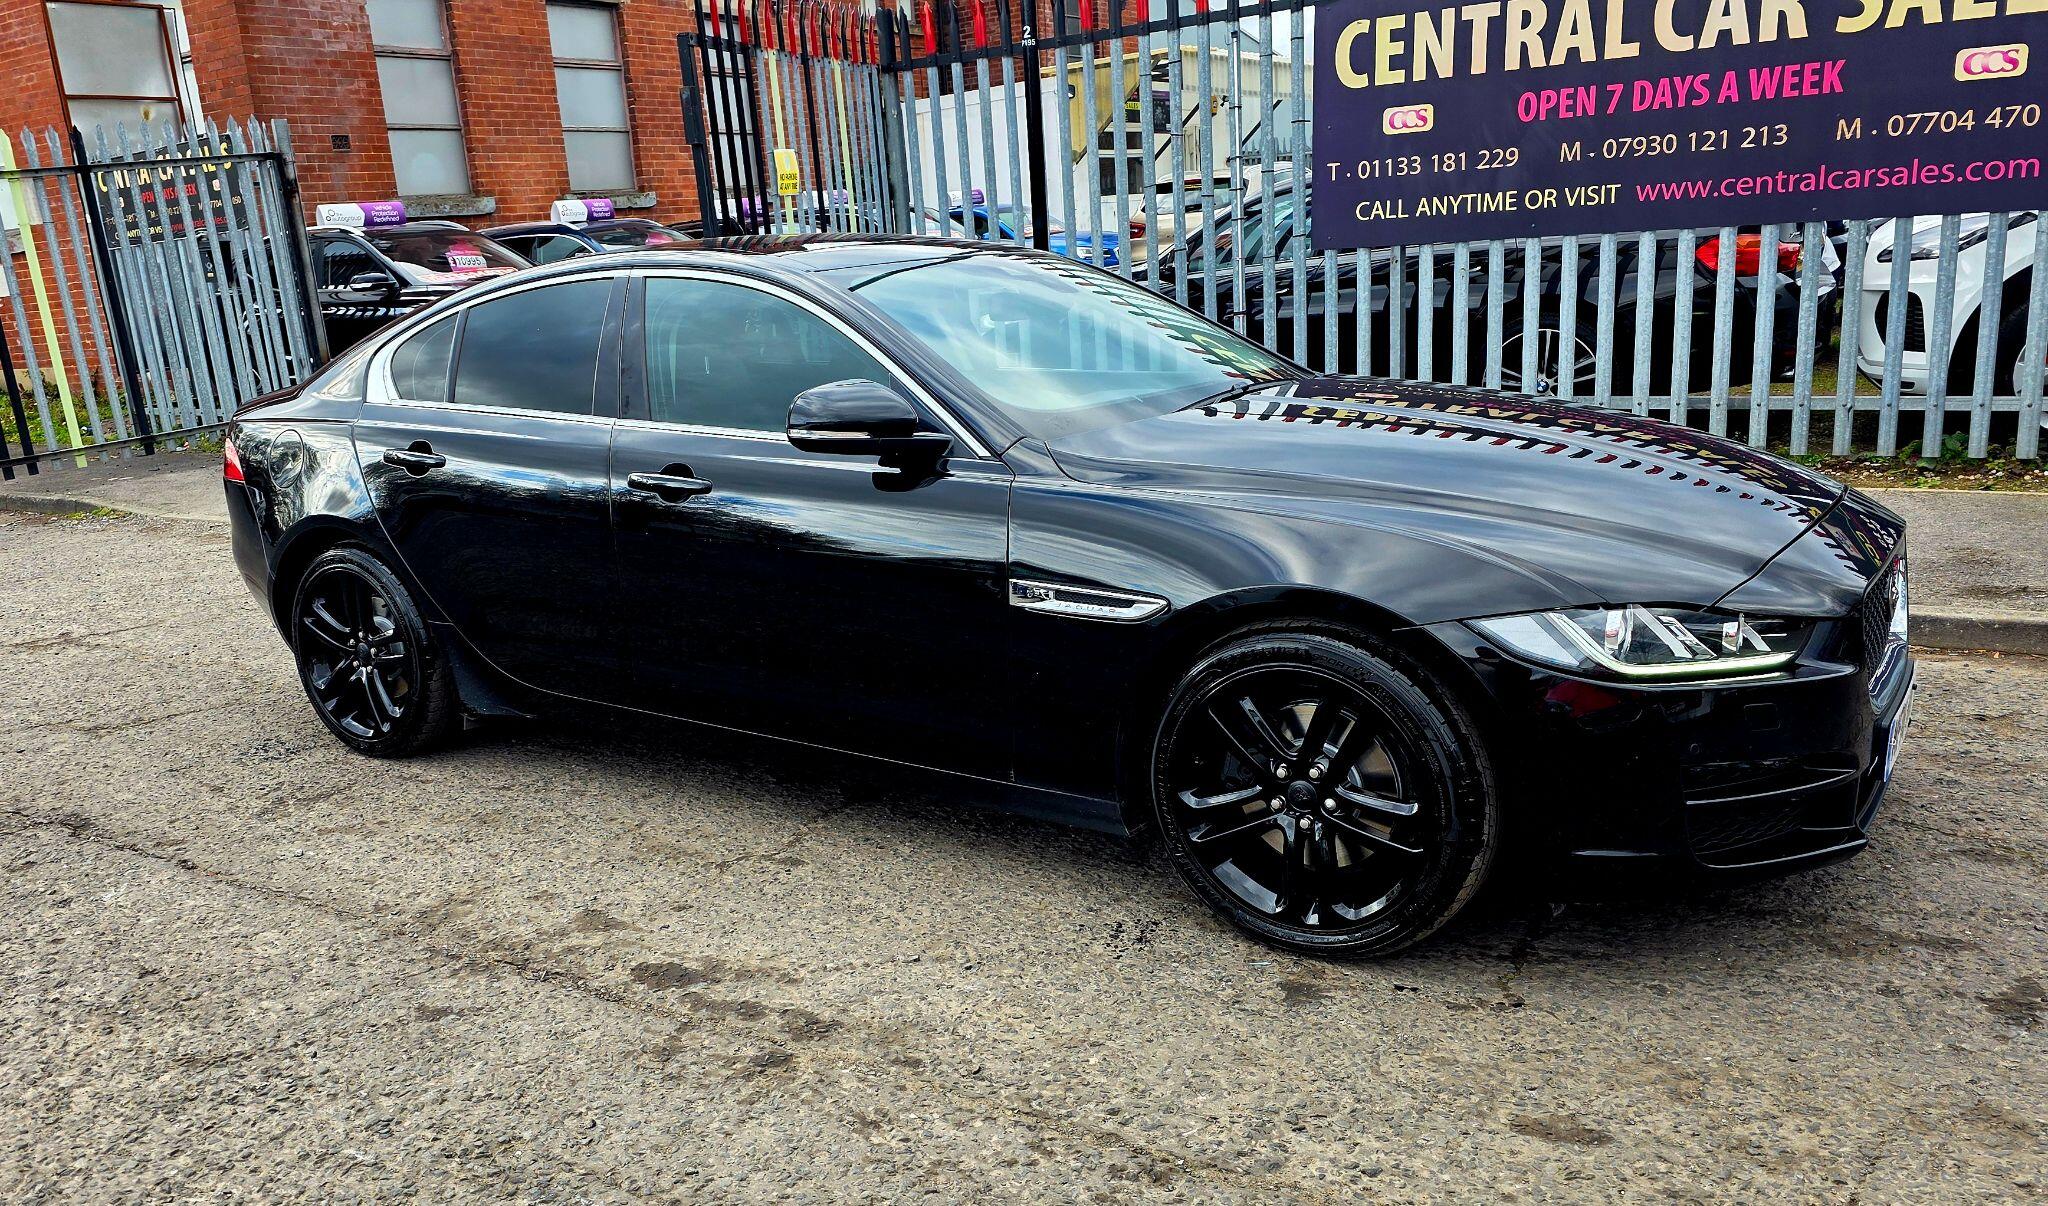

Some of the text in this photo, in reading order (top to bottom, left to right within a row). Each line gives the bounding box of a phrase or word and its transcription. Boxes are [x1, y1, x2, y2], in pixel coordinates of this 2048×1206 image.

[1023, 25, 1031, 38] 2
[1335, 0, 1640, 89] CENTRAL
[1653, 0, 1808, 52] CAR
[1517, 58, 1846, 122] OPEN 7 DAYS A WEEK
[1887, 109, 1976, 137] 07704
[1984, 103, 2041, 128] 470
[1602, 133, 1678, 159] 07930
[1688, 129, 1729, 151] 121
[1740, 123, 1789, 148] 213
[1357, 155, 1422, 180] 01133
[1431, 151, 1467, 173] 181
[1475, 147, 1520, 170] 229
[1636, 157, 2041, 202] www.centralcarsales.com
[1355, 183, 1622, 221] CALL ANYTIME OR VISIT
